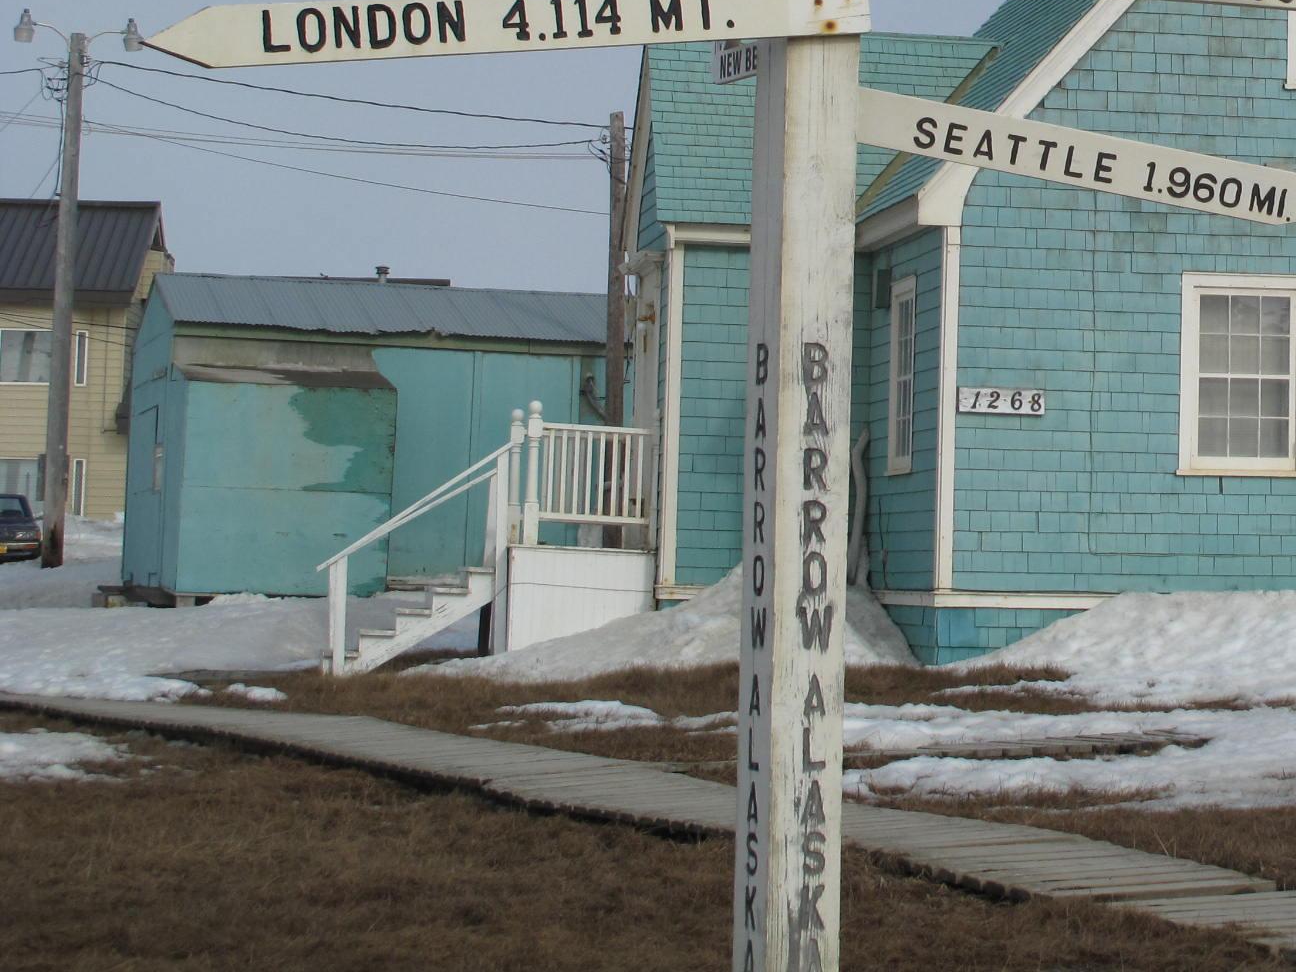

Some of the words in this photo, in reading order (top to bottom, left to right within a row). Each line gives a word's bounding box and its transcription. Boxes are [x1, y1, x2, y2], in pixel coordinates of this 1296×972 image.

[261, 0, 467, 54] LONDON
[719, 49, 742, 79] NEW
[912, 115, 1118, 185] SEATTLE
[1143, 161, 1243, 208] 1.960
[1248, 184, 1292, 224] MI.
[970, 390, 1042, 412] 1268
[751, 343, 769, 650] BARROW
[799, 342, 833, 652] BARROW
